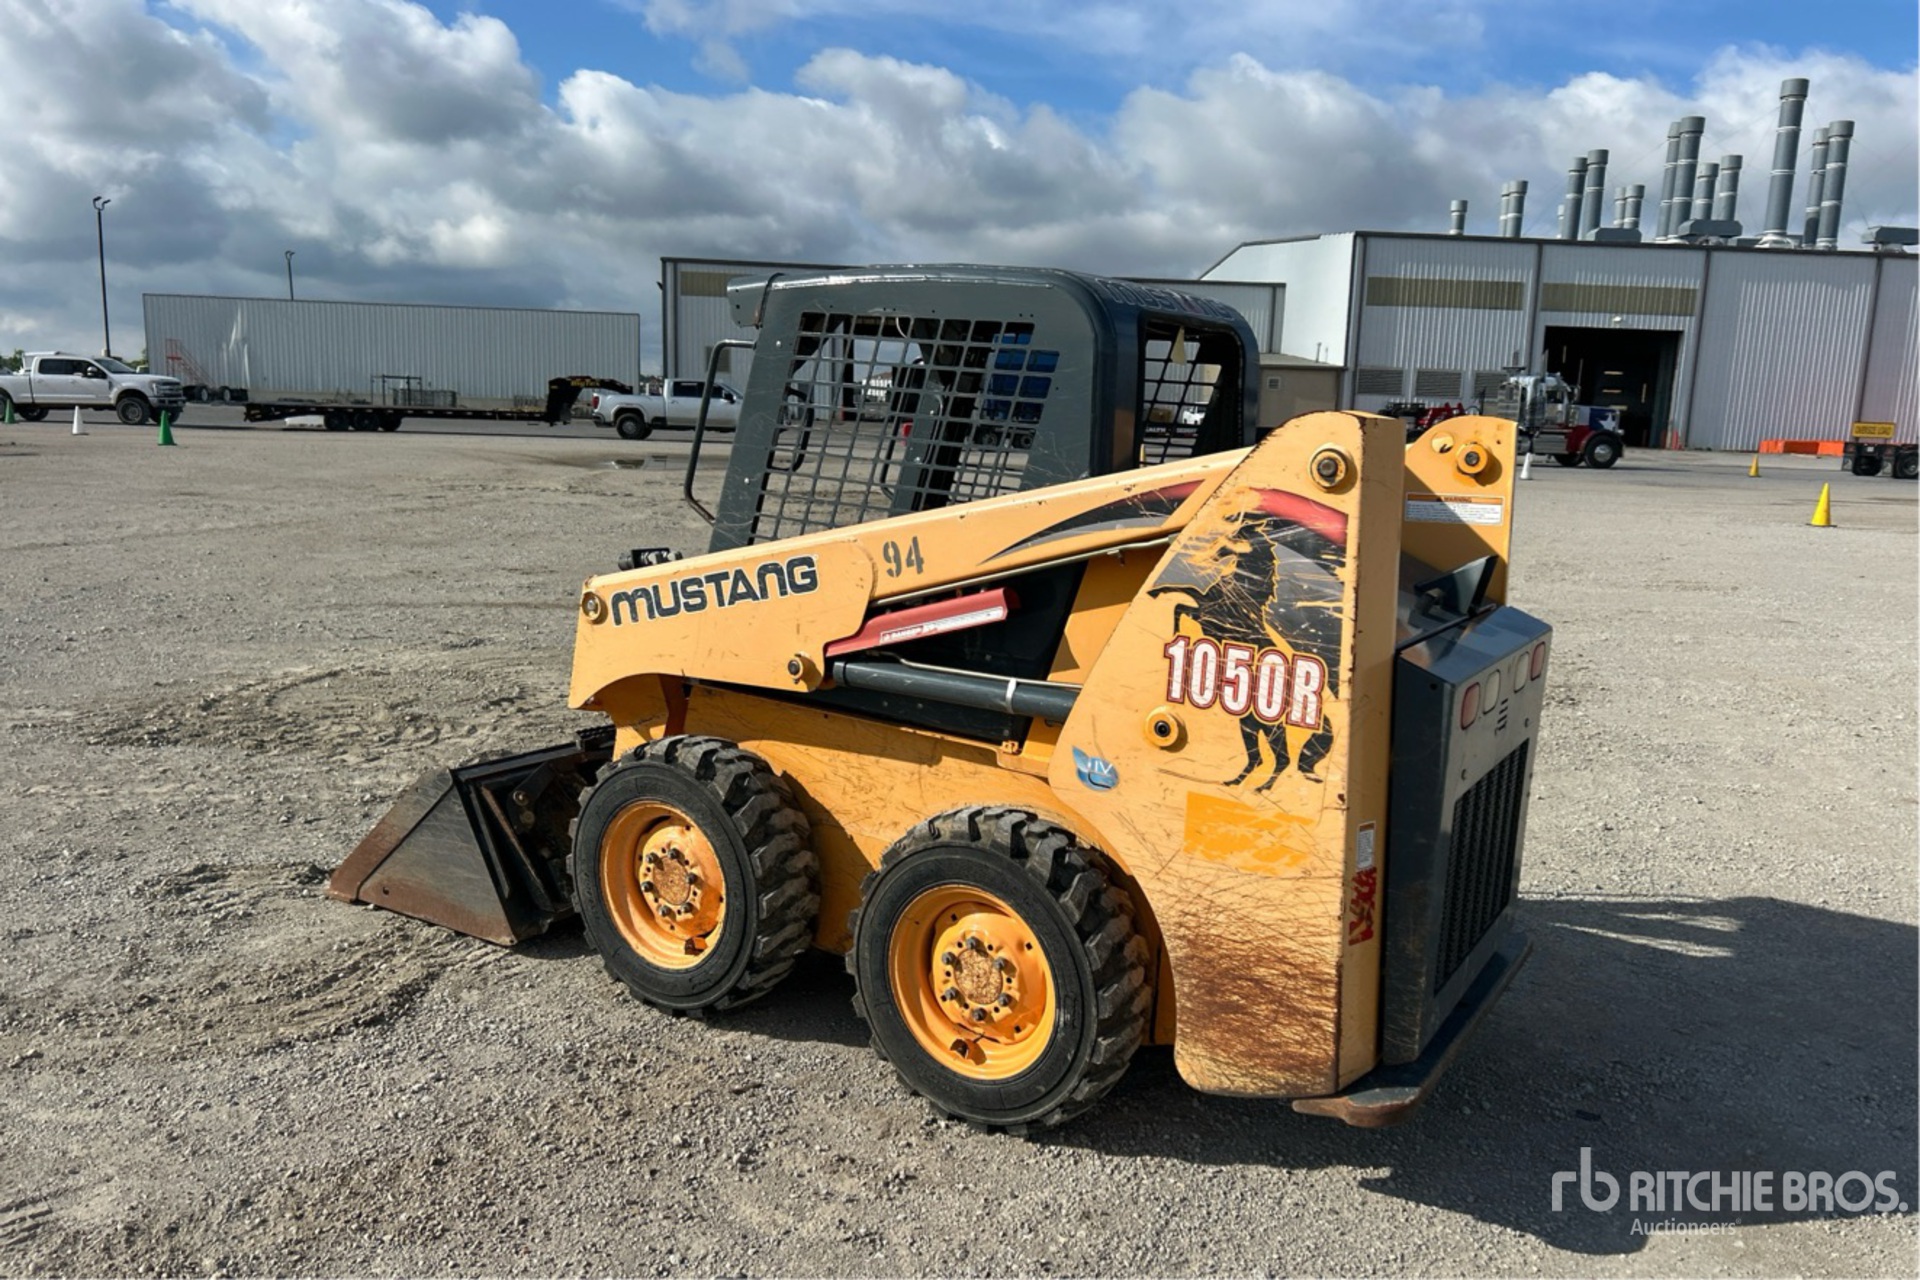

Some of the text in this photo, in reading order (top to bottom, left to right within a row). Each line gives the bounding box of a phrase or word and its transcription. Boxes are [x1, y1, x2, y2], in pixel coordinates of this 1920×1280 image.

[611, 556, 817, 626] MUSTANG
[882, 535, 925, 578] 94
[1164, 633, 1328, 731] 1050R
